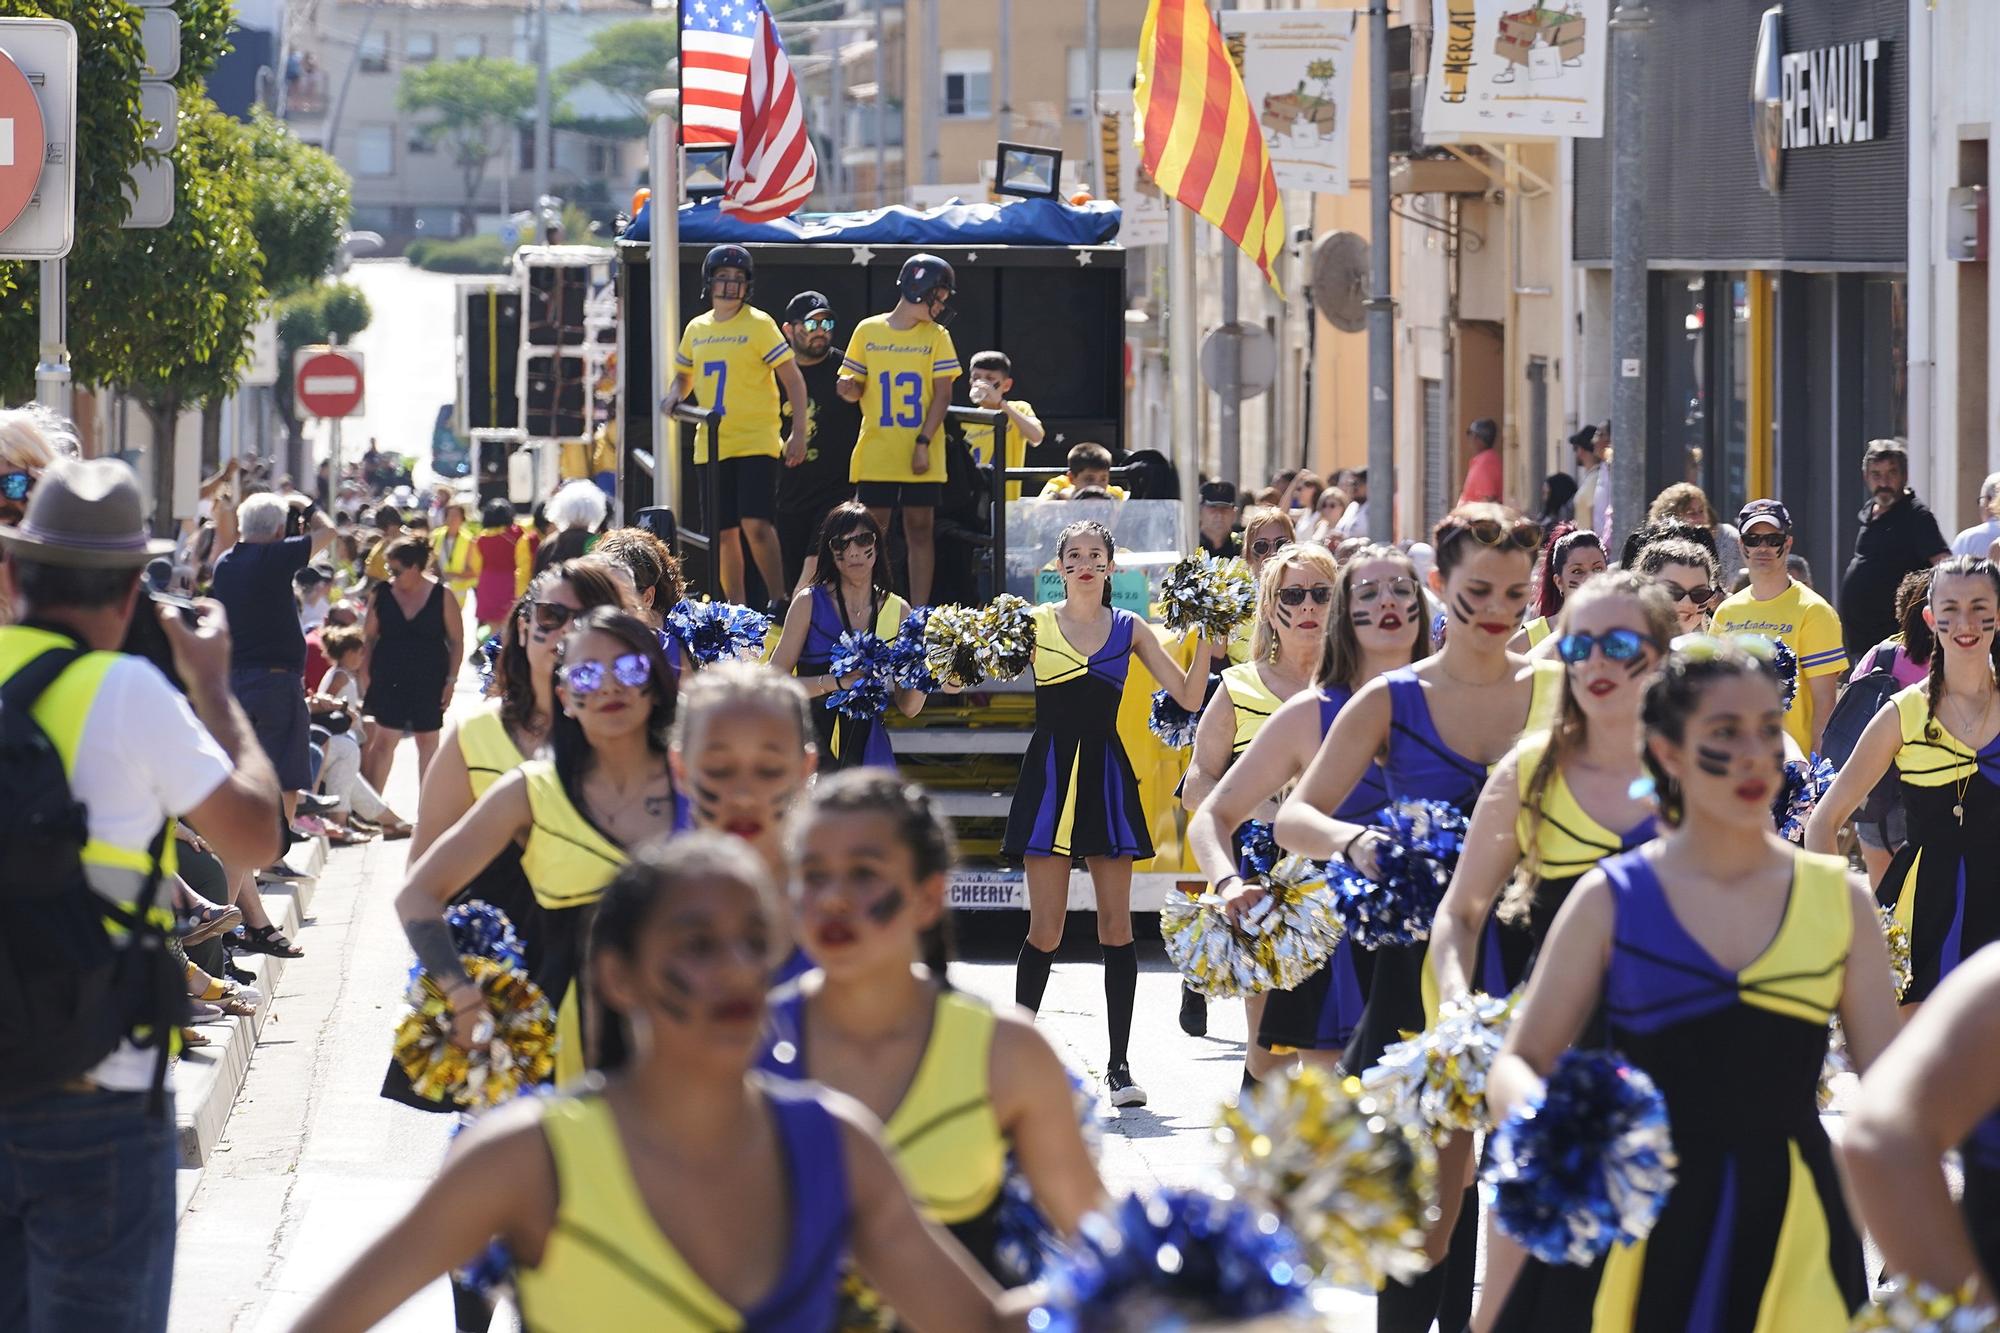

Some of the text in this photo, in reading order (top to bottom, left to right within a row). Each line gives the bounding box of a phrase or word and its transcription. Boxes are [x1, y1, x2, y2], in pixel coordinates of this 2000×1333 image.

[1440, 9, 1478, 104] EL MERCAT
[1781, 38, 1879, 149] RENAULT
[703, 360, 727, 416] 7
[879, 370, 923, 428] 13
[951, 884, 1014, 904] CHEERLY
